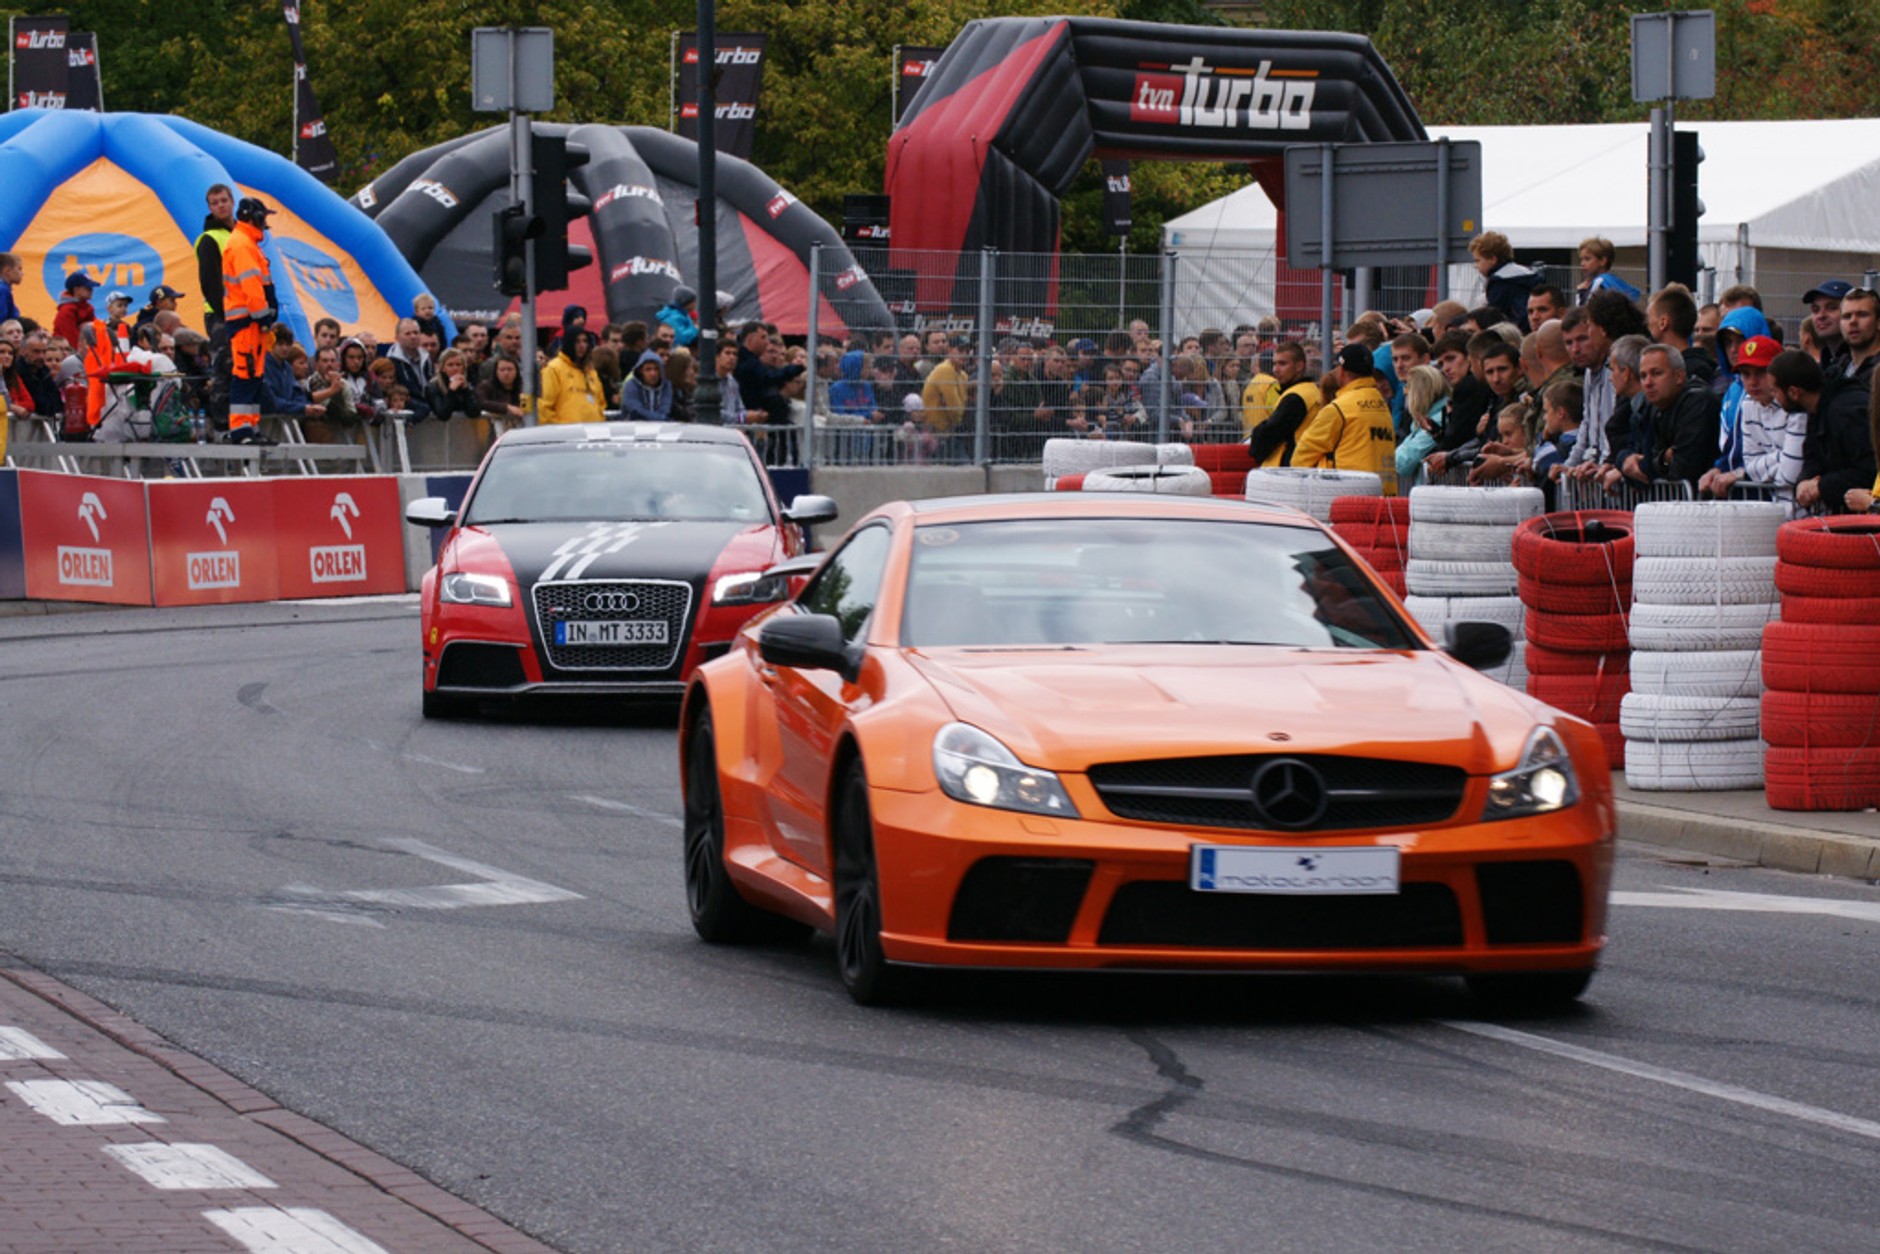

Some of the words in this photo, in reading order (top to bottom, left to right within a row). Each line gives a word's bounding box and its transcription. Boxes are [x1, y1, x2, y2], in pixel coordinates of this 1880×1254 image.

[27, 29, 66, 49] turbo
[714, 46, 761, 64] urbo
[1138, 80, 1175, 112] tvn
[1170, 56, 1316, 130] turbo
[1008, 315, 1055, 338] turbo
[61, 551, 109, 581] ORLEN
[191, 558, 237, 584] ORLEN
[314, 550, 362, 578] ORLEN
[568, 624, 587, 641] IN
[600, 624, 620, 641] MT
[624, 623, 666, 641] 3333
